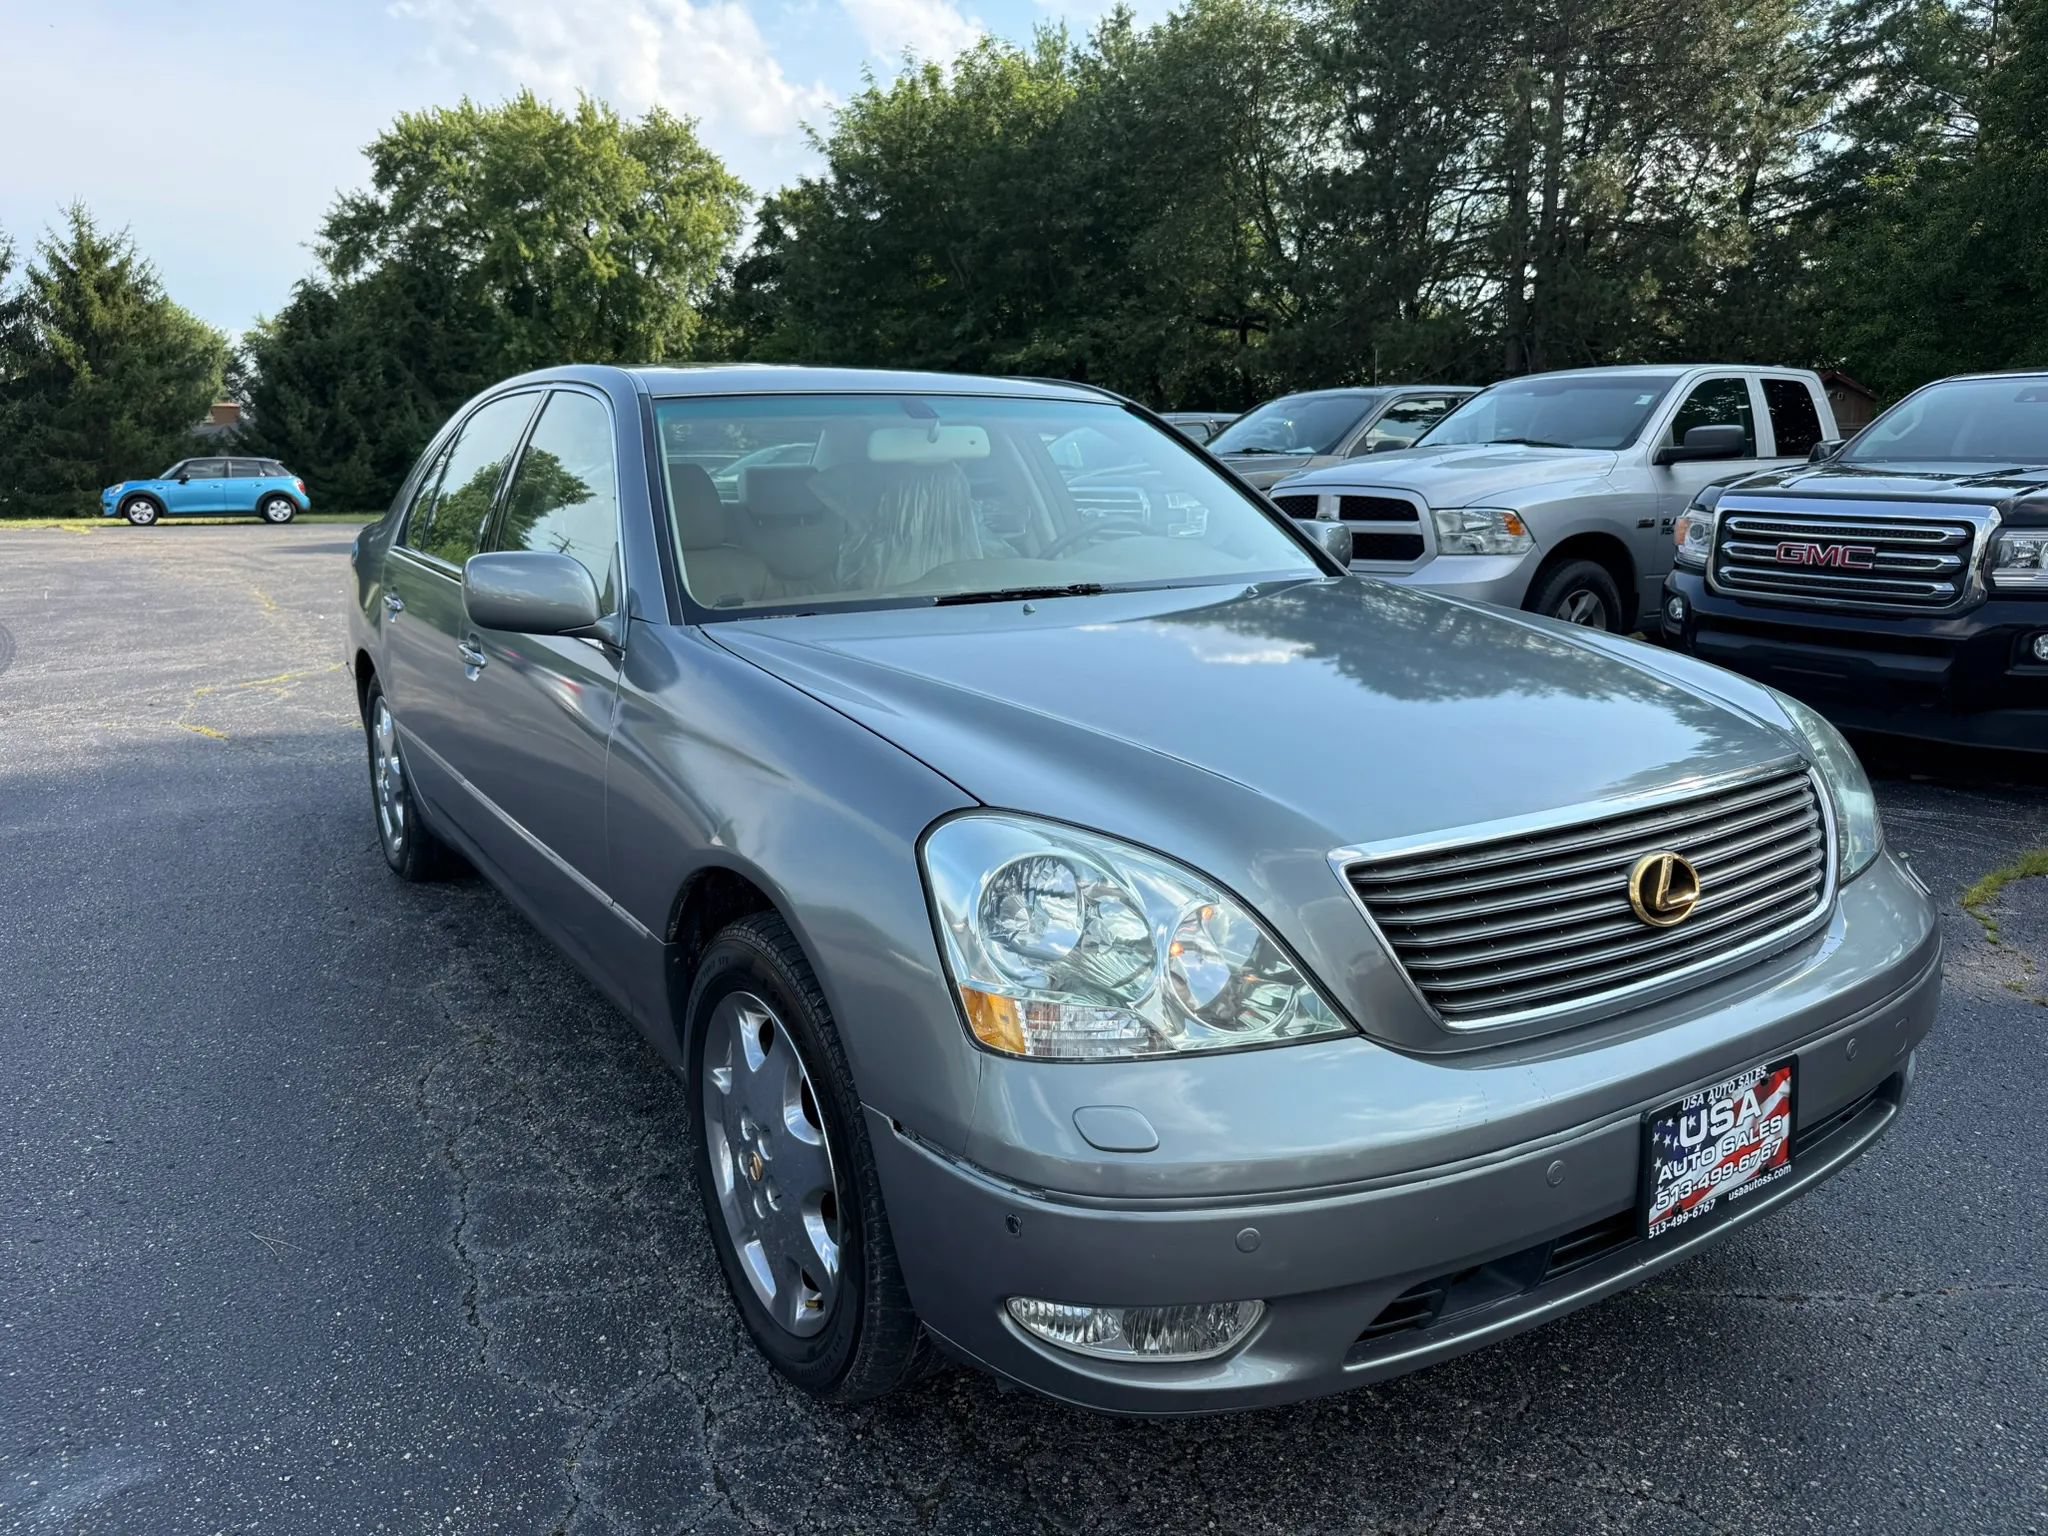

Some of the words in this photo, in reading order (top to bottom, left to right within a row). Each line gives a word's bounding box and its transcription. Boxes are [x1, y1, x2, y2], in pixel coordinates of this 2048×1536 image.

[1776, 541, 1876, 570] GMC
[1679, 1088, 1762, 1148] USA
[1681, 1093, 1704, 1111] USA
[1707, 1082, 1735, 1102] AUTO
[1737, 1065, 1767, 1088] SALES
[1657, 1148, 1716, 1184] AUTO
[1721, 1115, 1783, 1157] SALES
[1648, 1199, 1717, 1239] 513-499-6767
[1728, 1163, 1792, 1201] usaautoss.com
